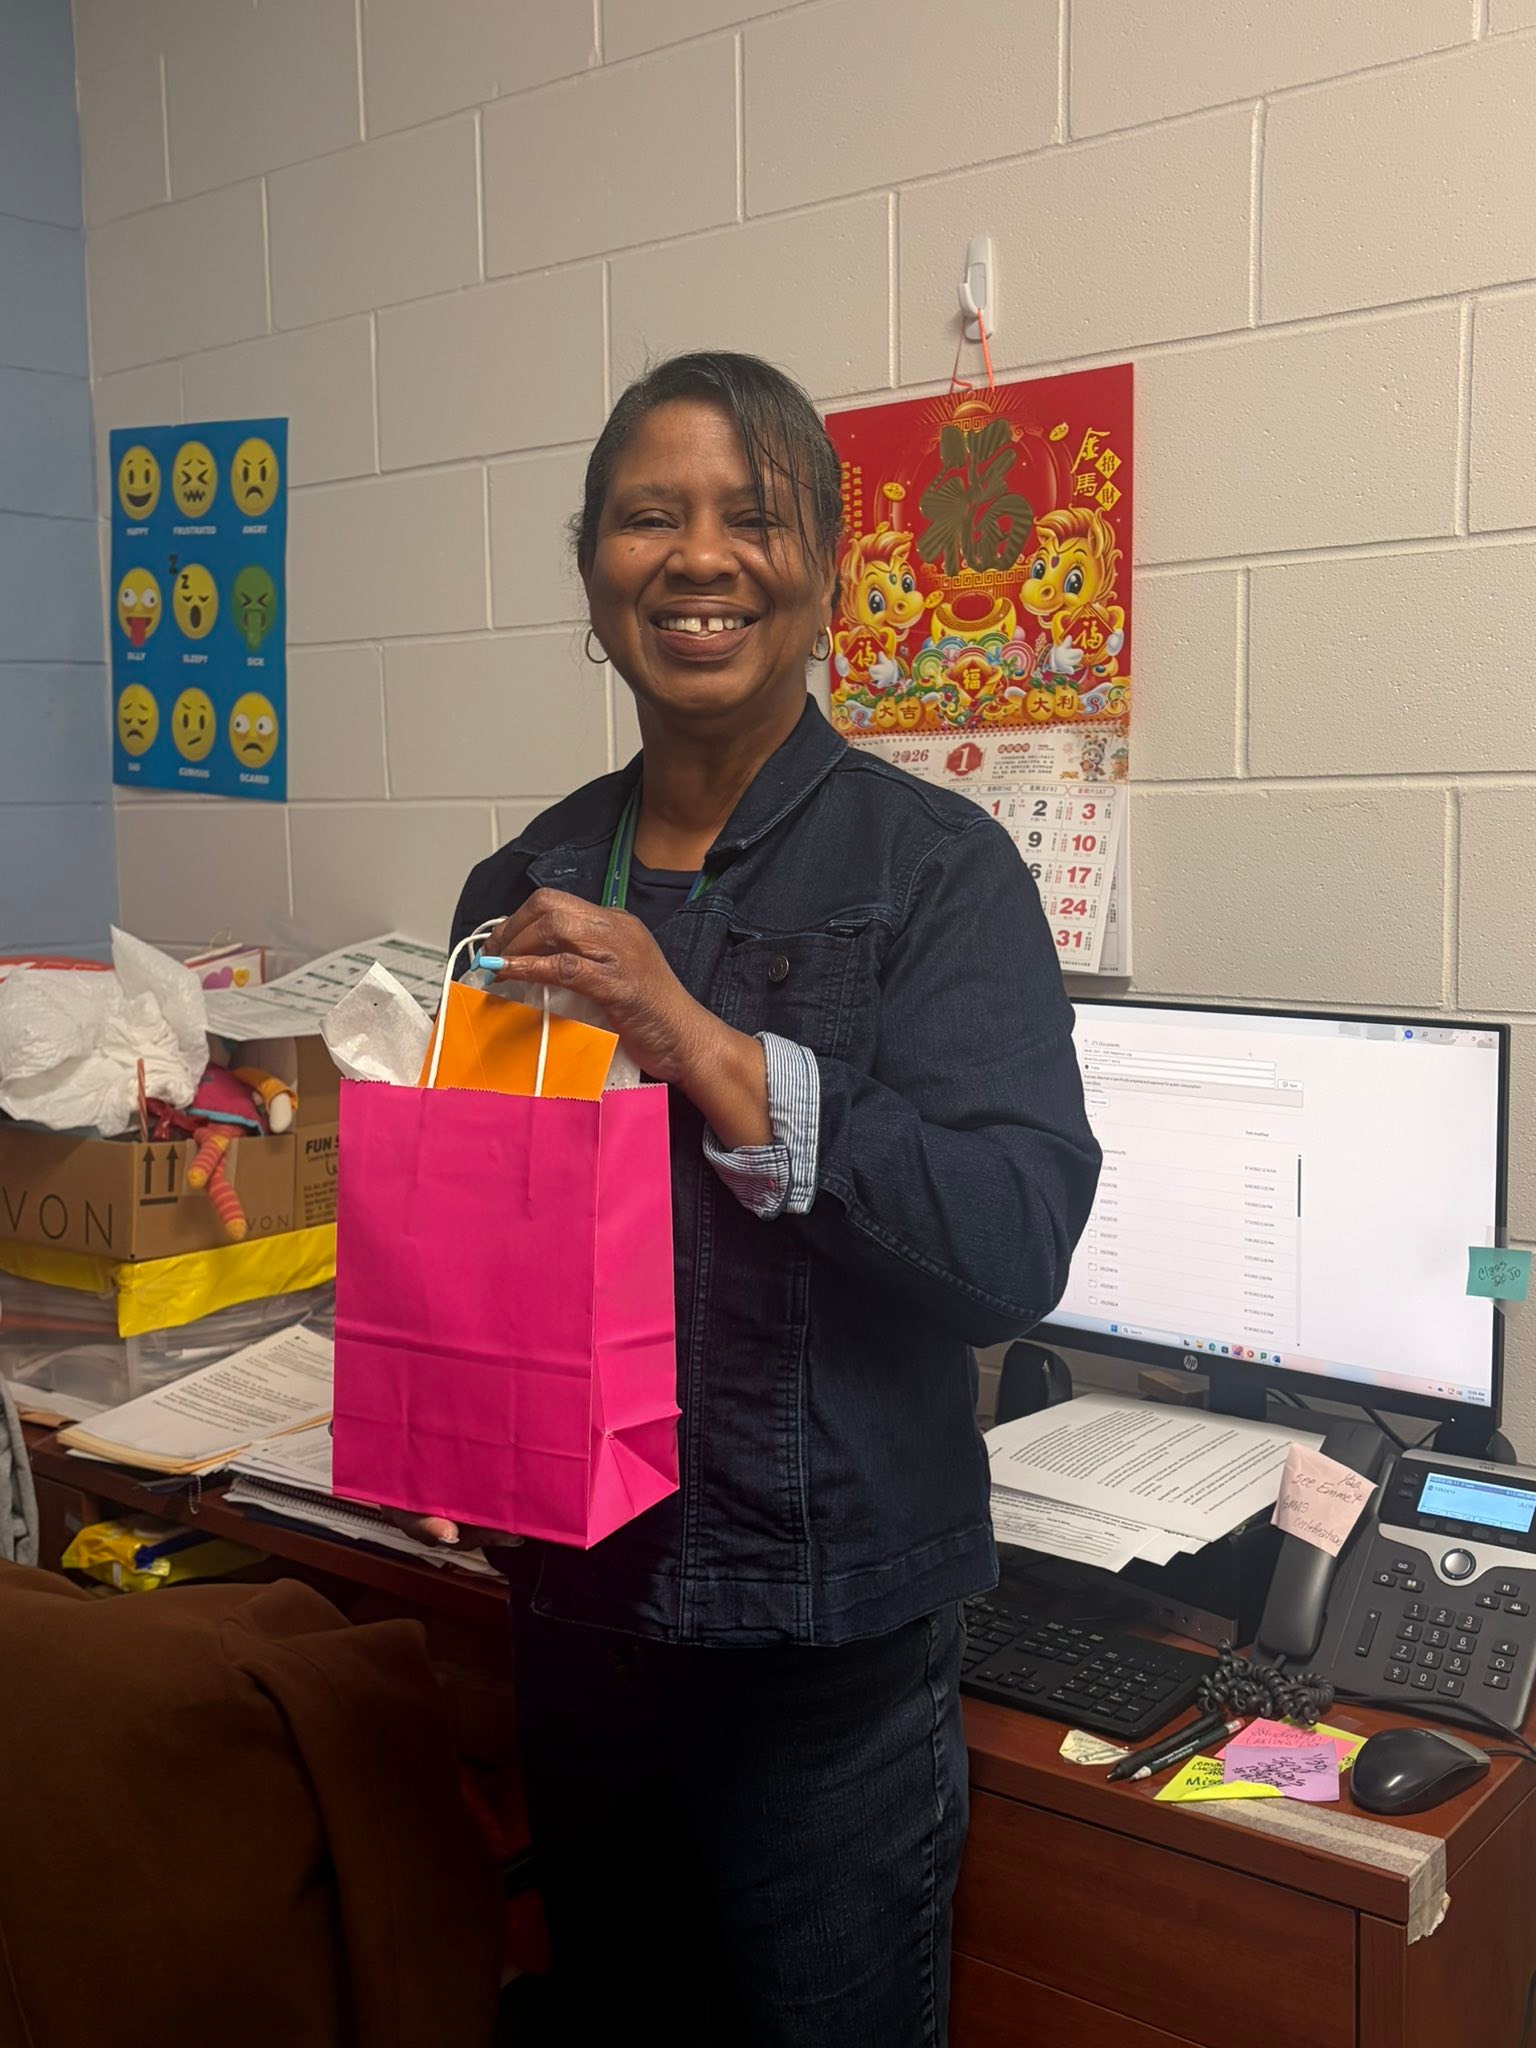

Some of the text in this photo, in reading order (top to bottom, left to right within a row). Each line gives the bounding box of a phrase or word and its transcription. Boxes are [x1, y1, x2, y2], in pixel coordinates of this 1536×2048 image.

[961, 668, 981, 690] 福
[878, 693, 1077, 720] 大吉 大利
[957, 747, 970, 772] 1
[992, 799, 1097, 820] 1 2 3
[1028, 831, 1097, 852] 9 10
[1067, 866, 1092, 884] 17
[1058, 898, 1088, 916] 24
[1055, 929, 1083, 948] 31
[306, 1136, 332, 1154] FUN
